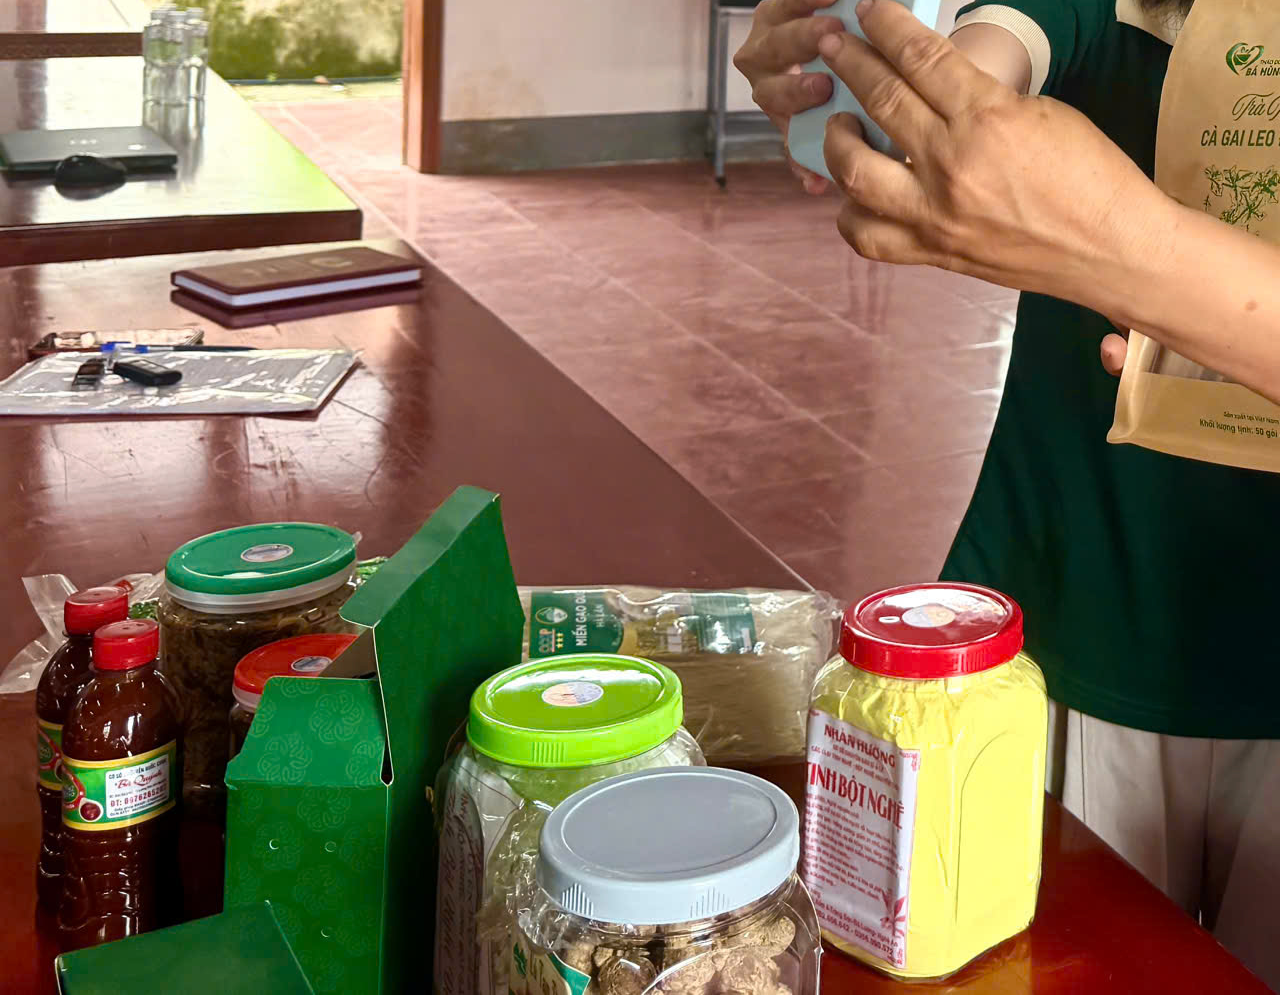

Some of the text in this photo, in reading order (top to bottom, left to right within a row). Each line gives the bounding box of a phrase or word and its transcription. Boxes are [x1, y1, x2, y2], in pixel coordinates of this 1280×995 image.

[1245, 65, 1258, 76] BÁ
[1221, 129, 1246, 147] GAI
[1247, 129, 1275, 147] LEO
[1255, 427, 1264, 436] 50
[838, 774, 867, 807] BỘT
